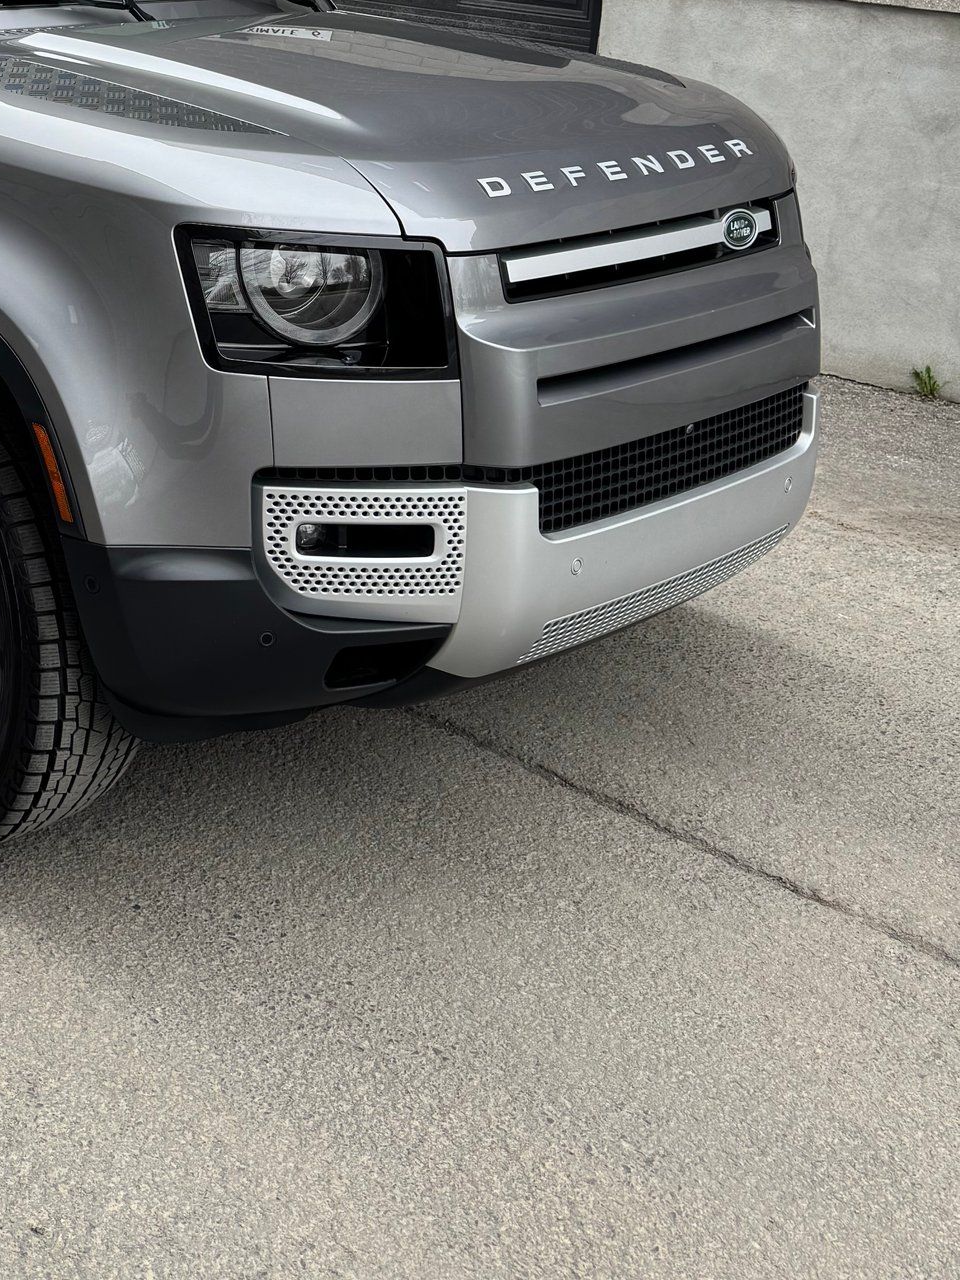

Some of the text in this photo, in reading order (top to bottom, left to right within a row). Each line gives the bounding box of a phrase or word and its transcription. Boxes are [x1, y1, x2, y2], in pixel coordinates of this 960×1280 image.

[476, 138, 754, 198] DEFENDER
[730, 219, 745, 231] LAND
[733, 227, 751, 239] ROVER
